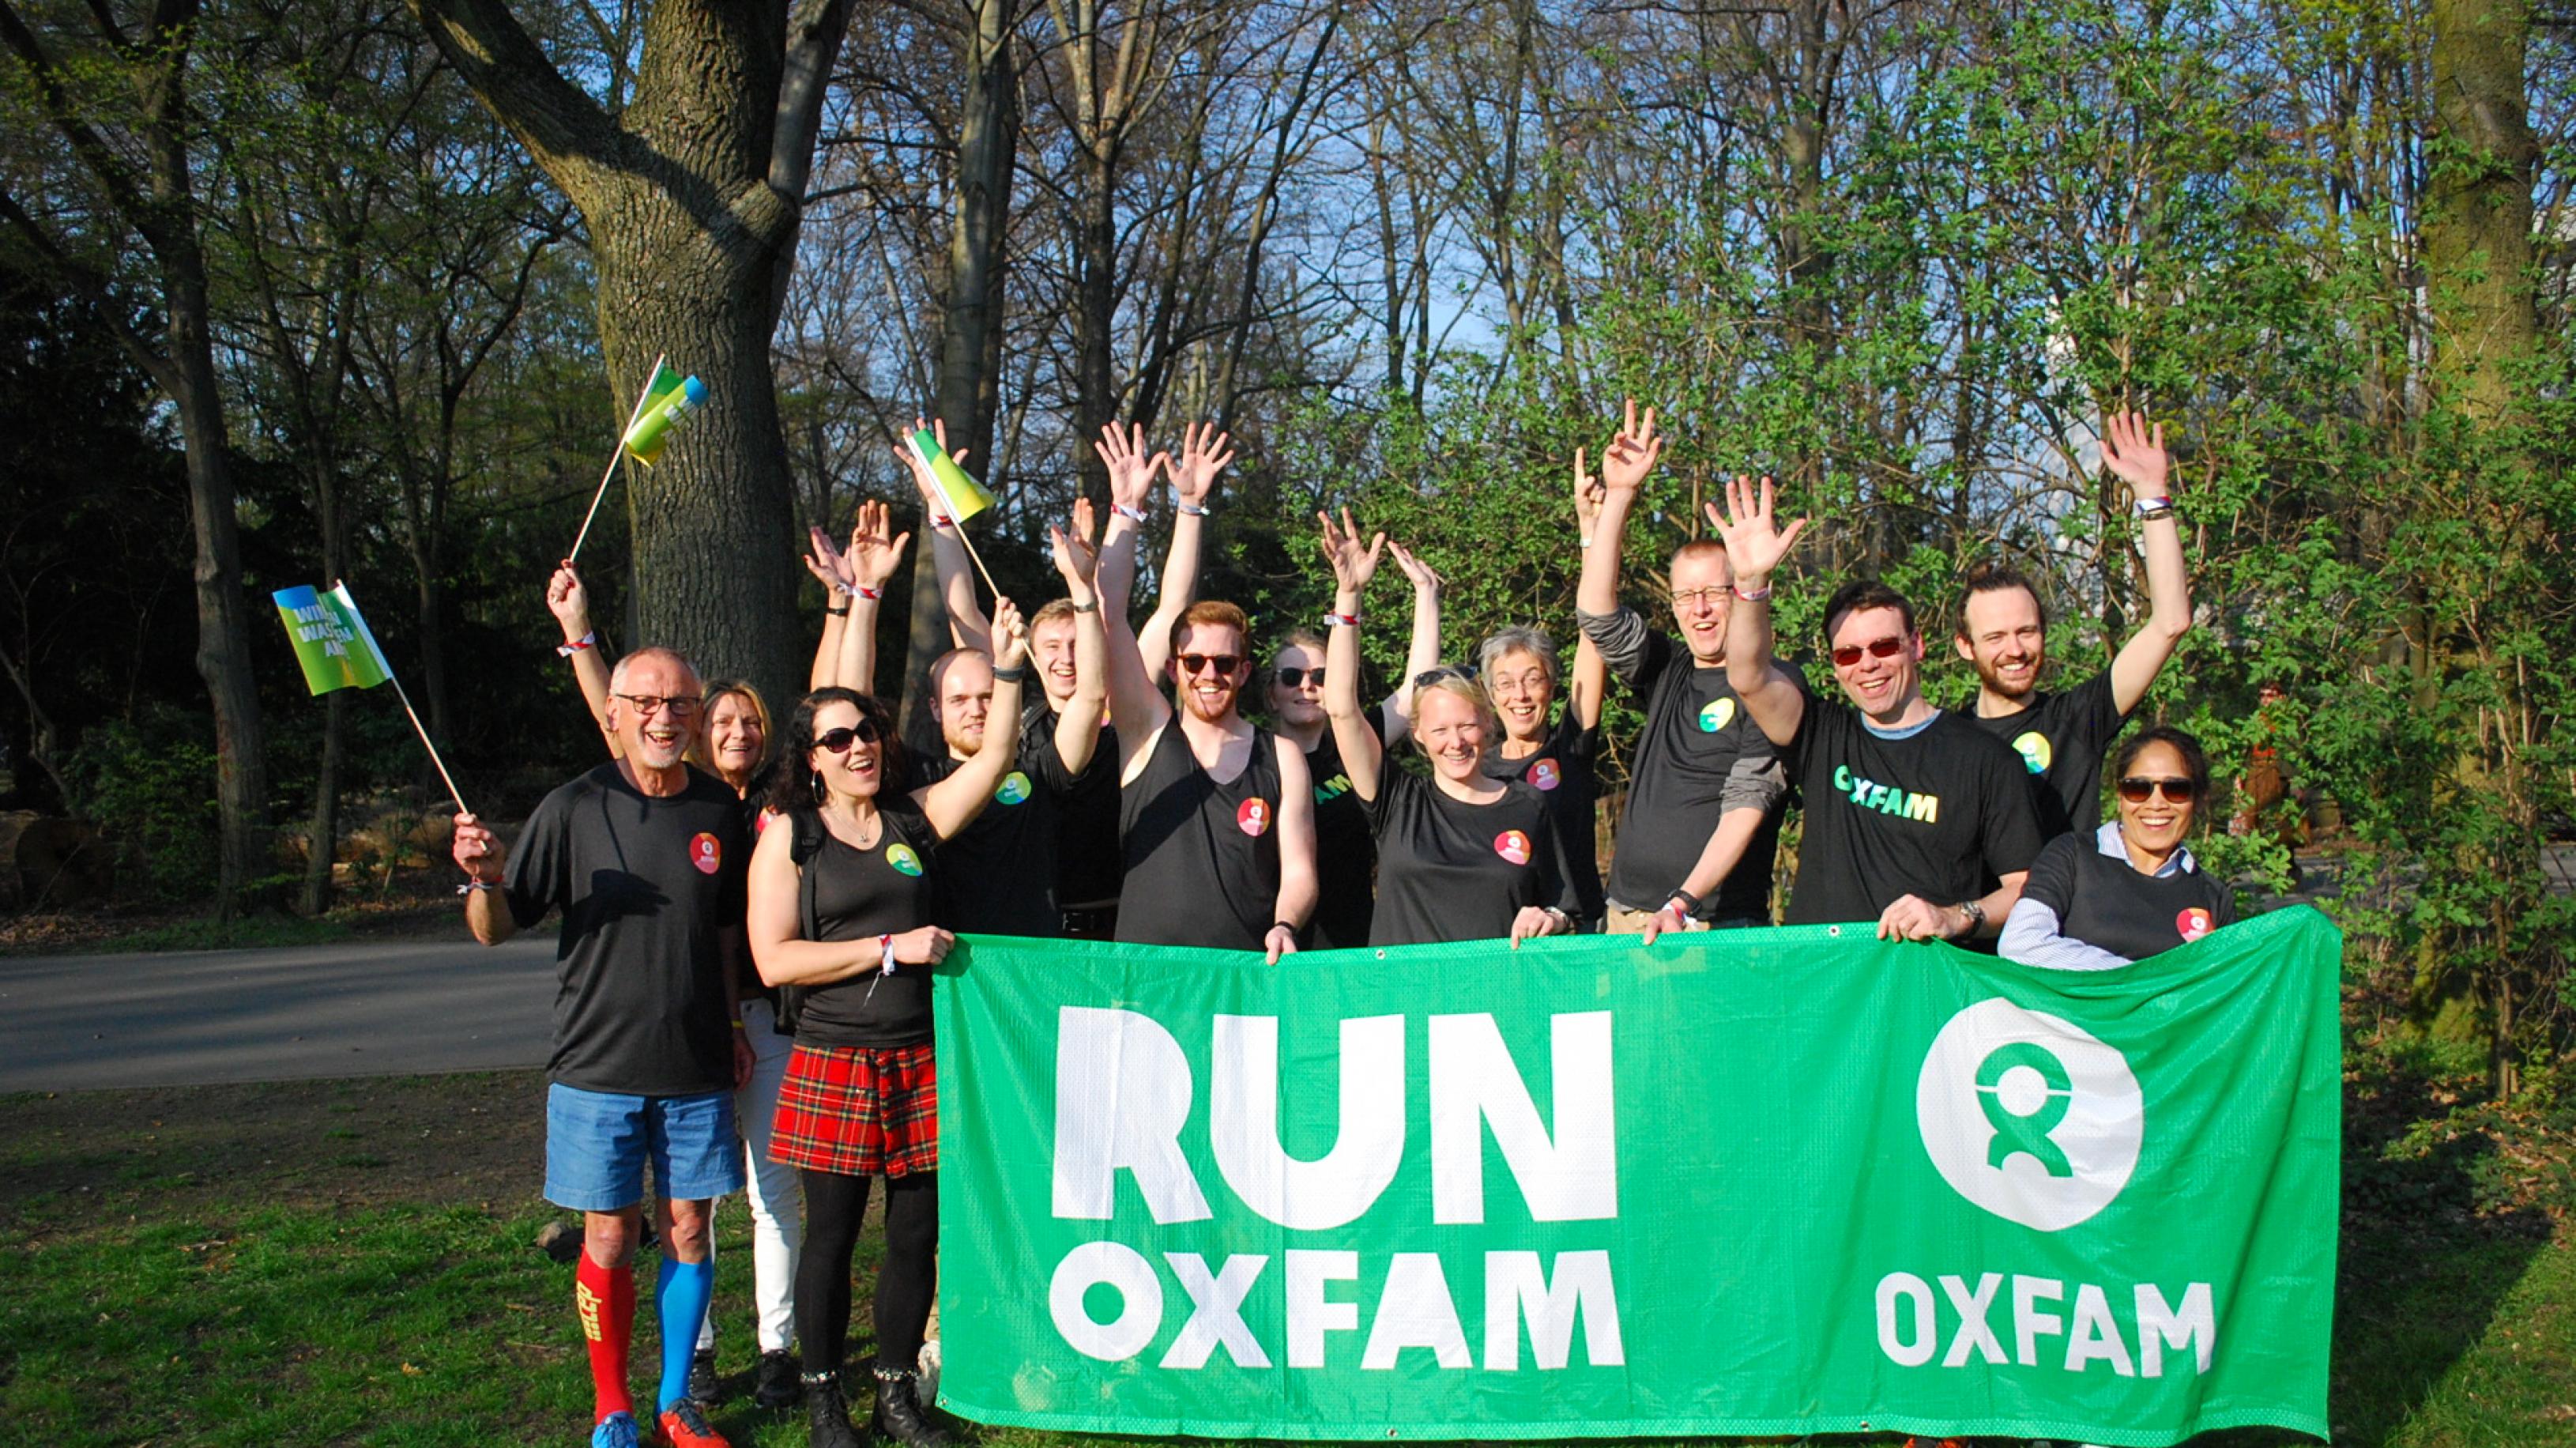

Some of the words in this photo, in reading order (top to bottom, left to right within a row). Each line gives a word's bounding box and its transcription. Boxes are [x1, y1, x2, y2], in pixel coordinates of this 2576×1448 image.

[1834, 764, 1938, 824] OXFAM
[1052, 1005, 1618, 1231] RUN
[1049, 1241, 1625, 1371] OXFAM
[1875, 1271, 2216, 1378] OXFAM
